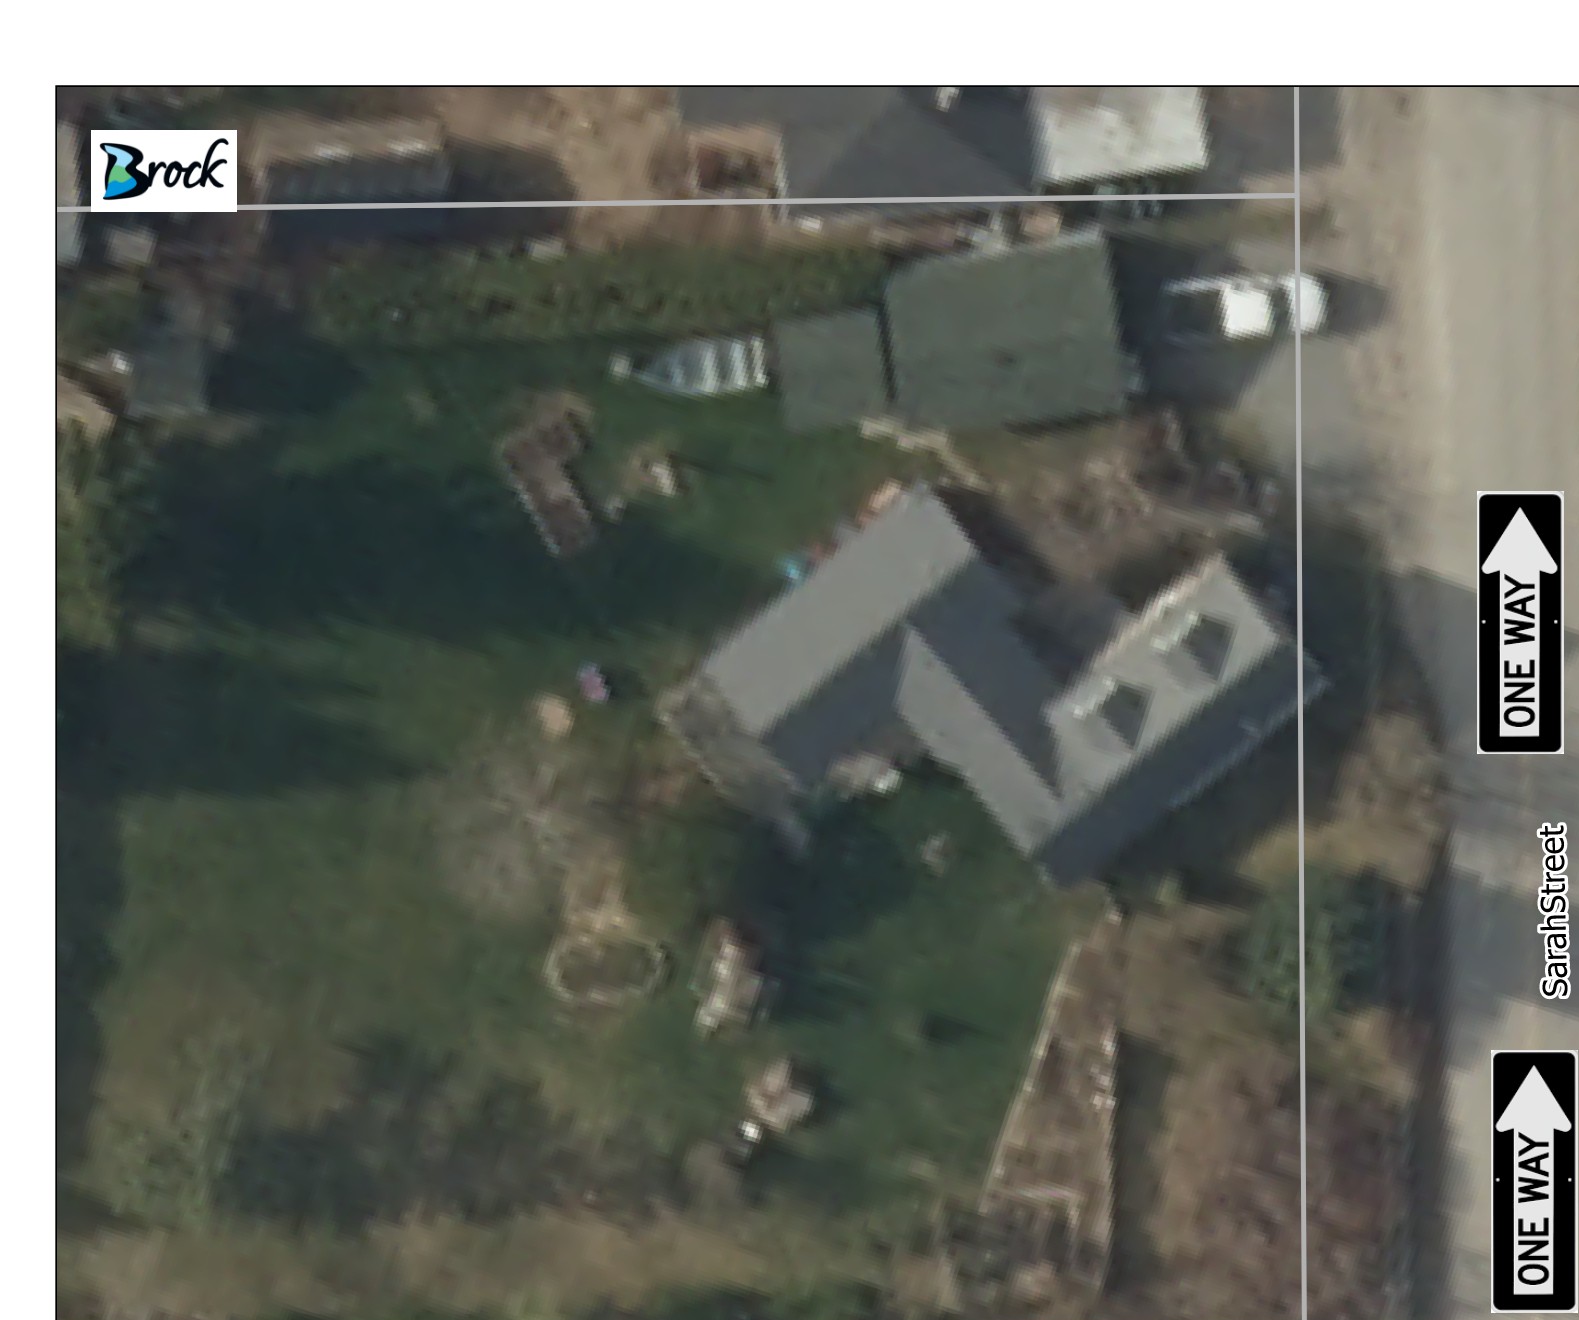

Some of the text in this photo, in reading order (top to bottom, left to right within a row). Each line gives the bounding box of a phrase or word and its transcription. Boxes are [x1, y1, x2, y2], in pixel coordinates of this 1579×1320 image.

[1503, 574, 1536, 728] ONE WAY
[1517, 1132, 1550, 1286] ONE WAY
